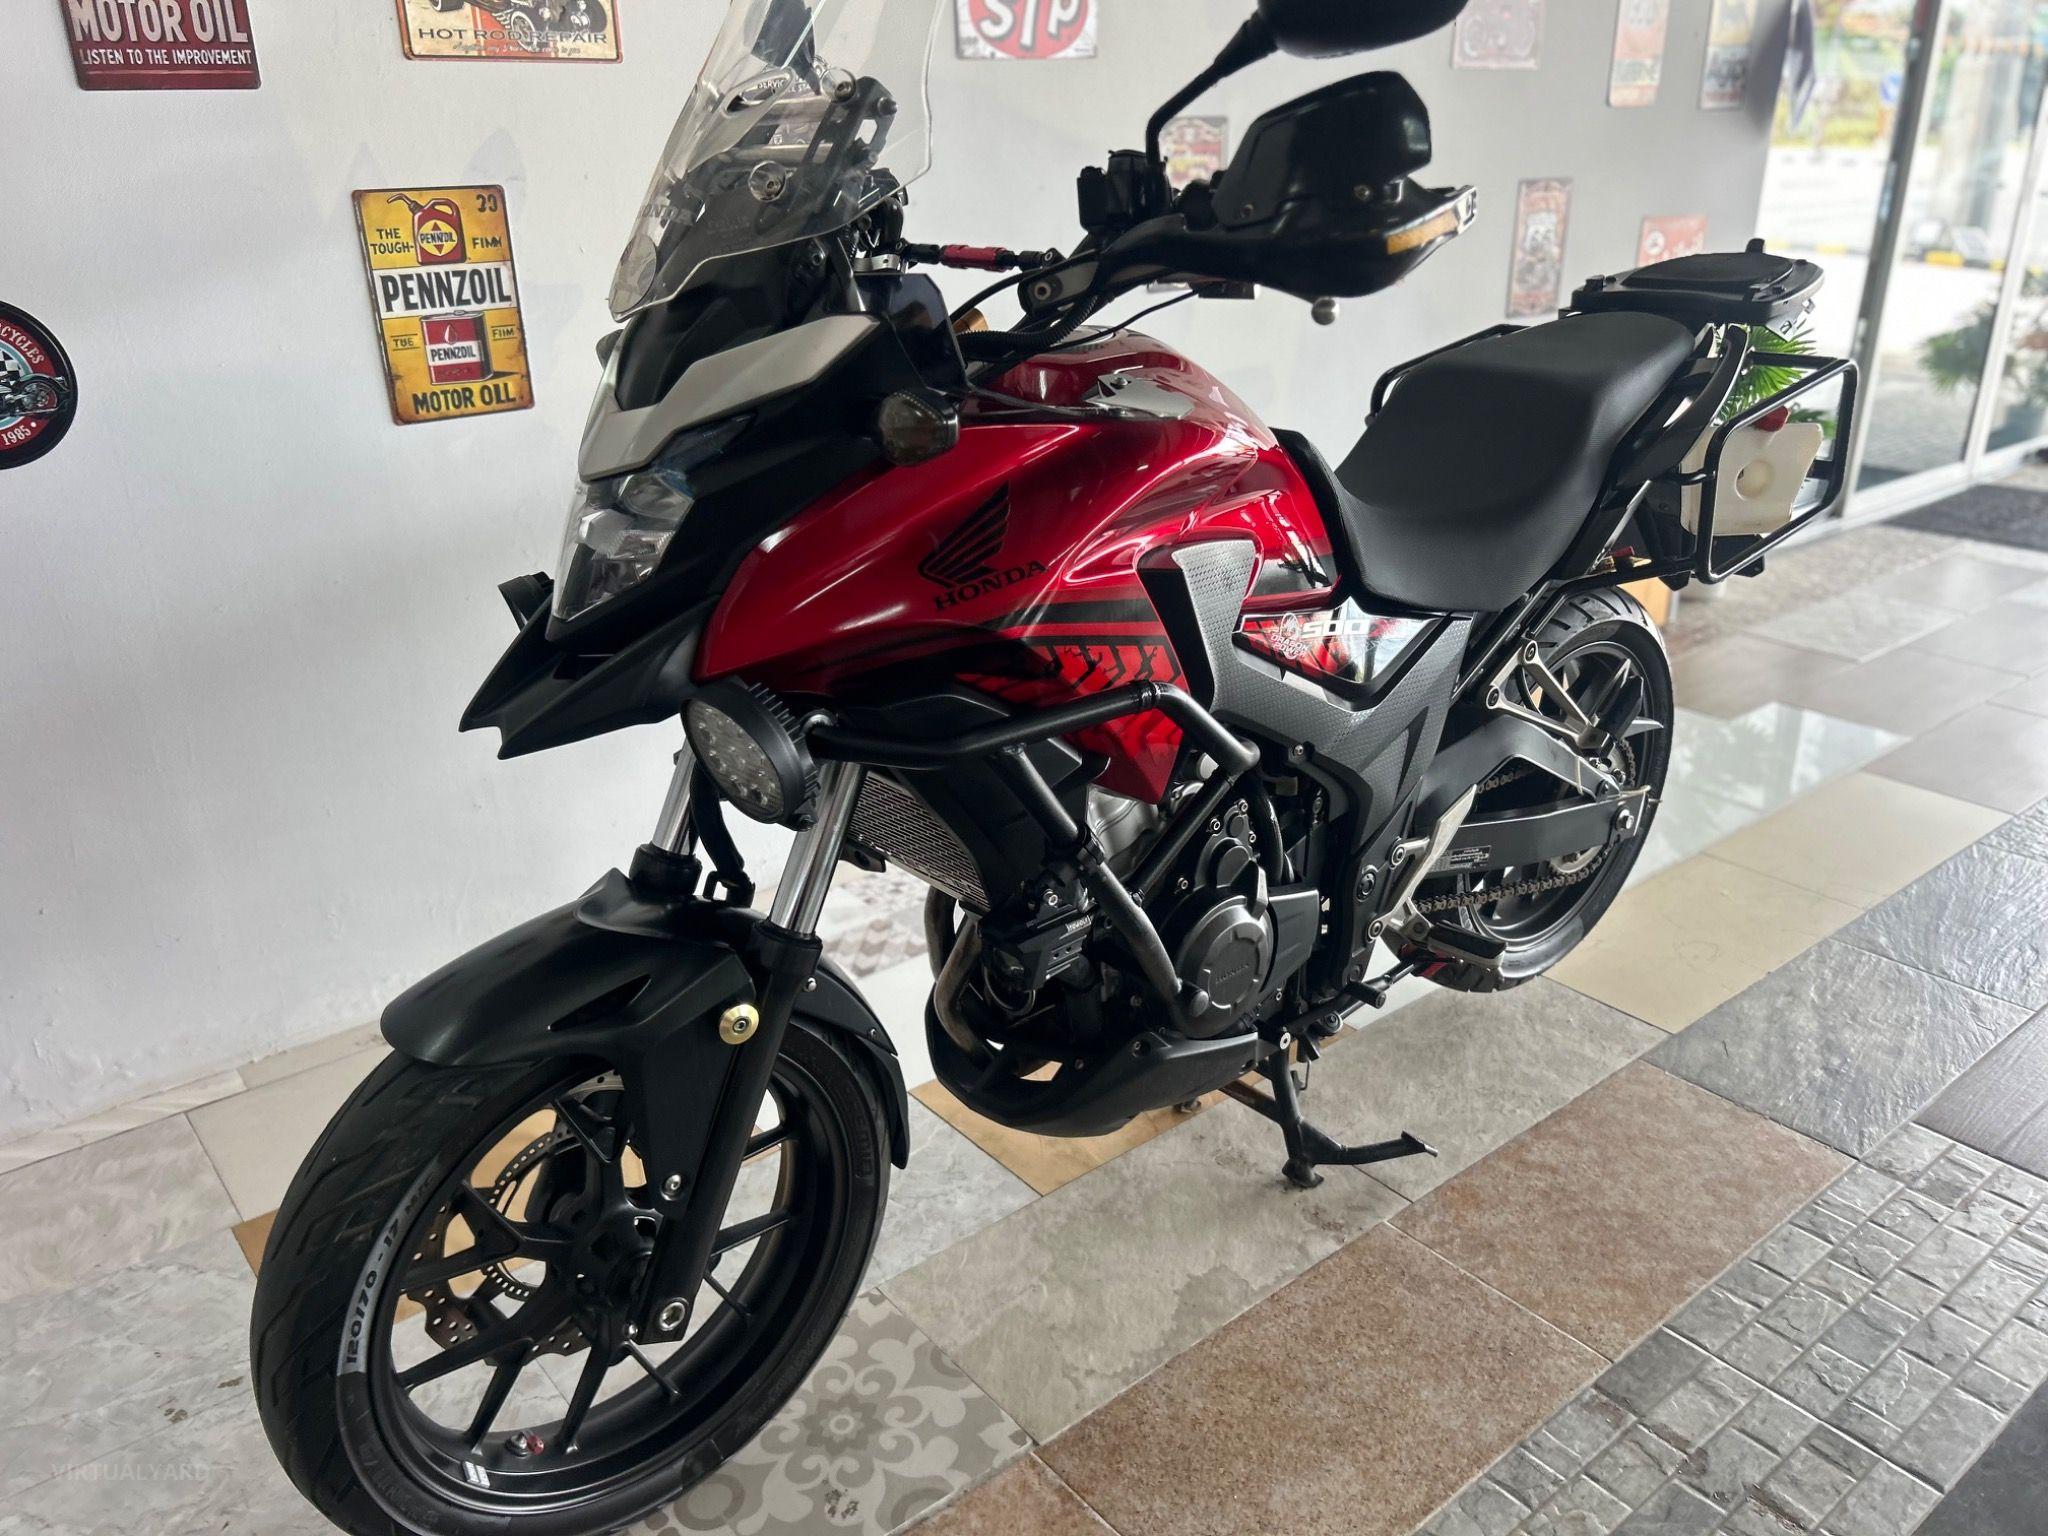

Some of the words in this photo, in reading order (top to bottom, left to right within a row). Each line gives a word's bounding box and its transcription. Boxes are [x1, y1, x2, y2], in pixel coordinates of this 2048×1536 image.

[70, 0, 187, 42] MOTOR
[190, 0, 249, 43] OIL
[418, 28, 466, 39] HOT
[474, 29, 523, 40] ROD
[529, 31, 607, 44] REPAIR
[80, 49, 124, 65] LISTEN
[128, 49, 143, 64] TO
[145, 49, 169, 64] THE
[172, 49, 252, 65] IMPROVEMENT
[376, 228, 401, 240] THE
[370, 241, 414, 255] TOUGH-
[380, 267, 511, 313] PENNZOIL
[0, 322, 45, 365] CYCLES
[431, 346, 476, 363] PENNZOIL
[411, 386, 475, 415] MOTOR
[480, 382, 516, 405] OIL
[2, 425, 32, 446] 1985
[933, 560, 1047, 612] HONDA
[1301, 619, 1370, 639] 500
[347, 1270, 378, 1364] 120/70
[384, 1218, 399, 1248] 17
